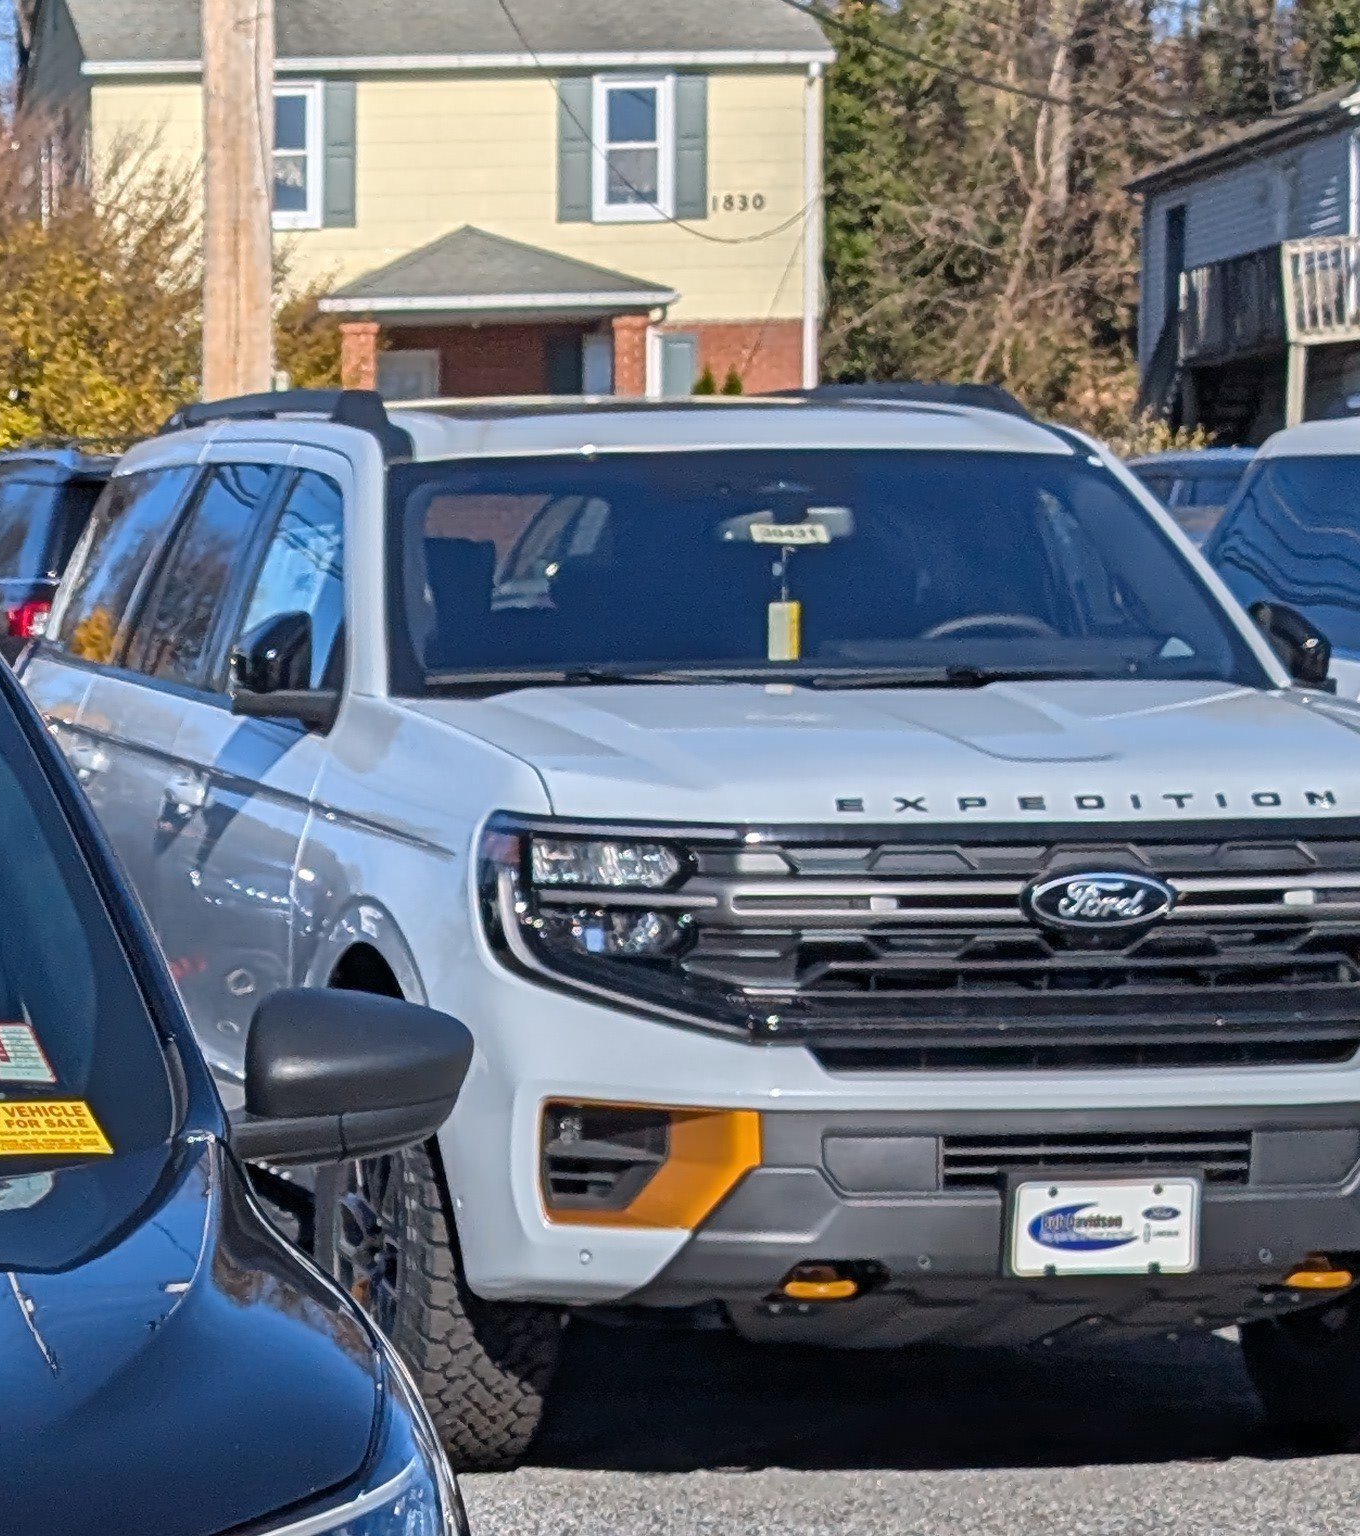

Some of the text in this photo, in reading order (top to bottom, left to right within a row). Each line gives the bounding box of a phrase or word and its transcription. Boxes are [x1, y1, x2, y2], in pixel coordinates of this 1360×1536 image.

[711, 192, 765, 212] 1830
[835, 790, 1338, 814] EXPEDITION
[1056, 879, 1148, 919] Ford
[2, 1105, 88, 1118] VEHICLE
[5, 1119, 41, 1129] FOR
[44, 1118, 89, 1129] SALE
